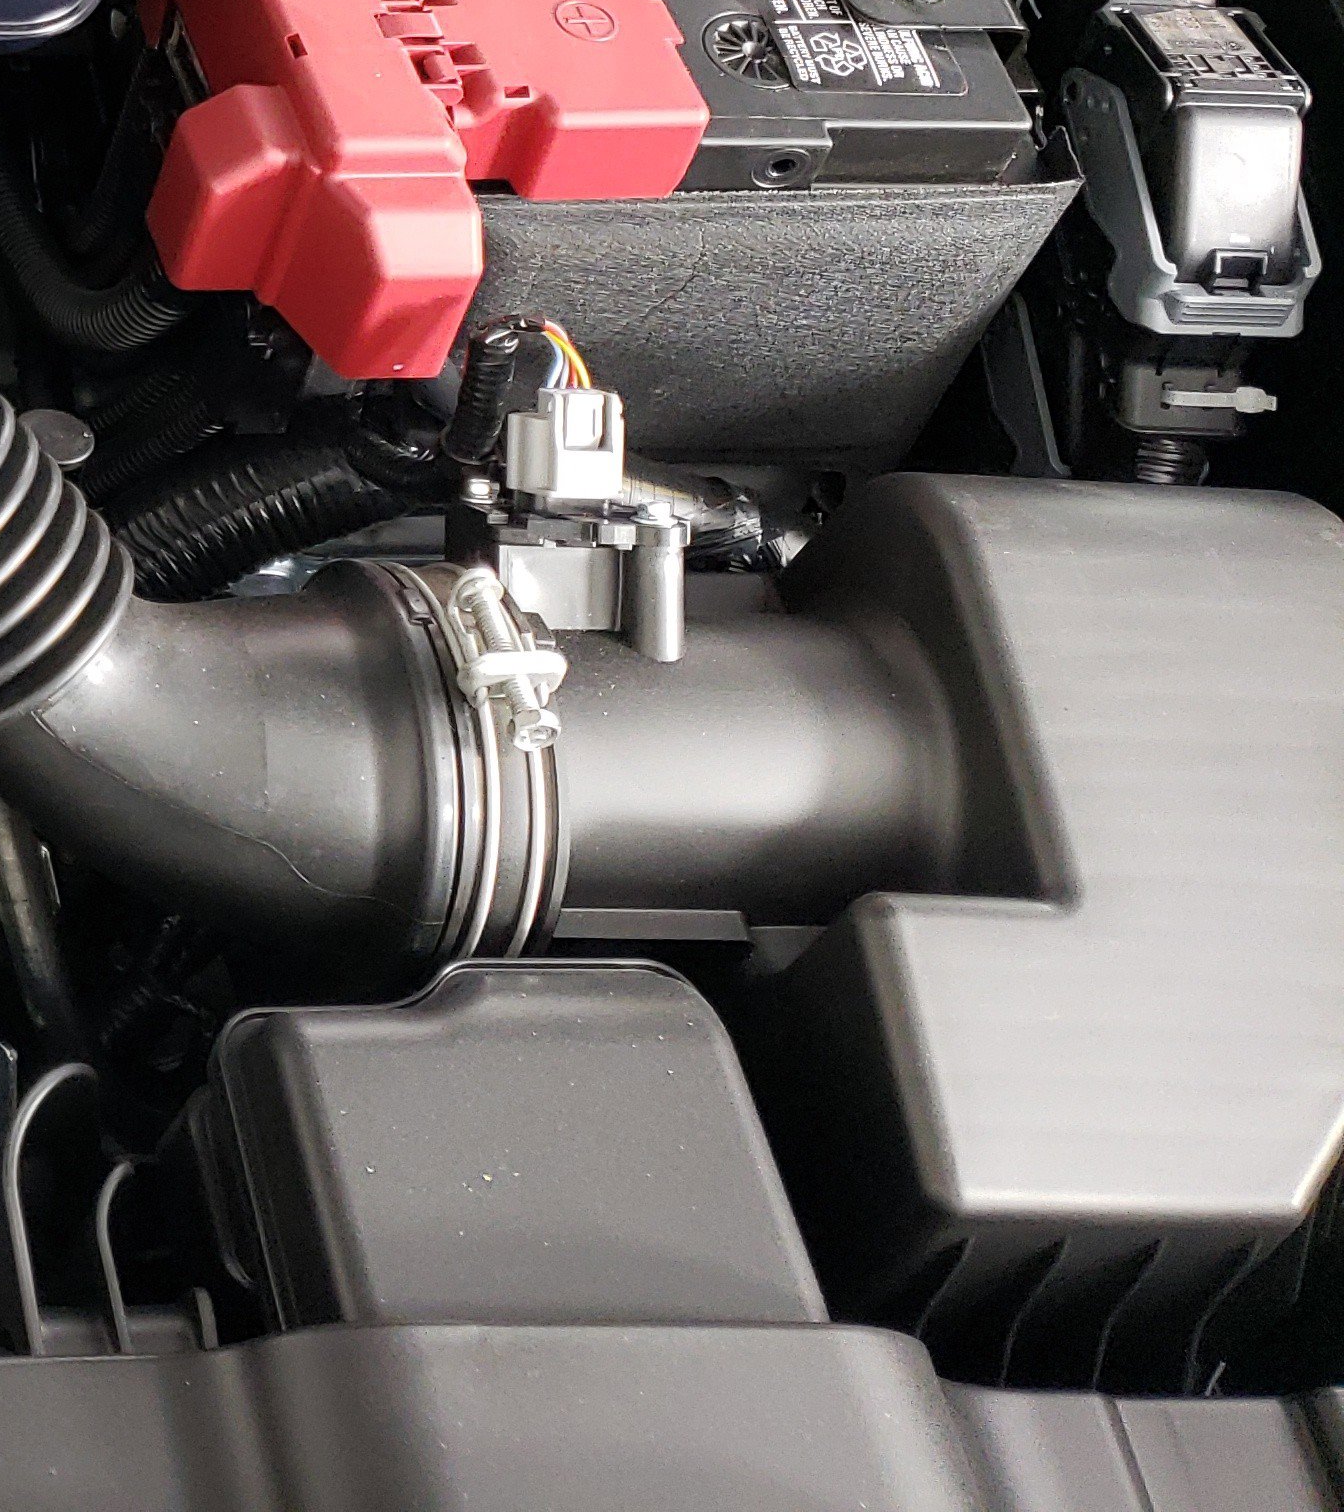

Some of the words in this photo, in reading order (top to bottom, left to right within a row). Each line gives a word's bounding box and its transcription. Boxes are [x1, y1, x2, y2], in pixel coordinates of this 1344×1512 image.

[829, 6, 842, 15] OF
[784, 39, 808, 80] RECYCLED
[891, 40, 911, 64] CAUSE
[801, 59, 821, 84] MUST
[891, 65, 904, 78] OR
